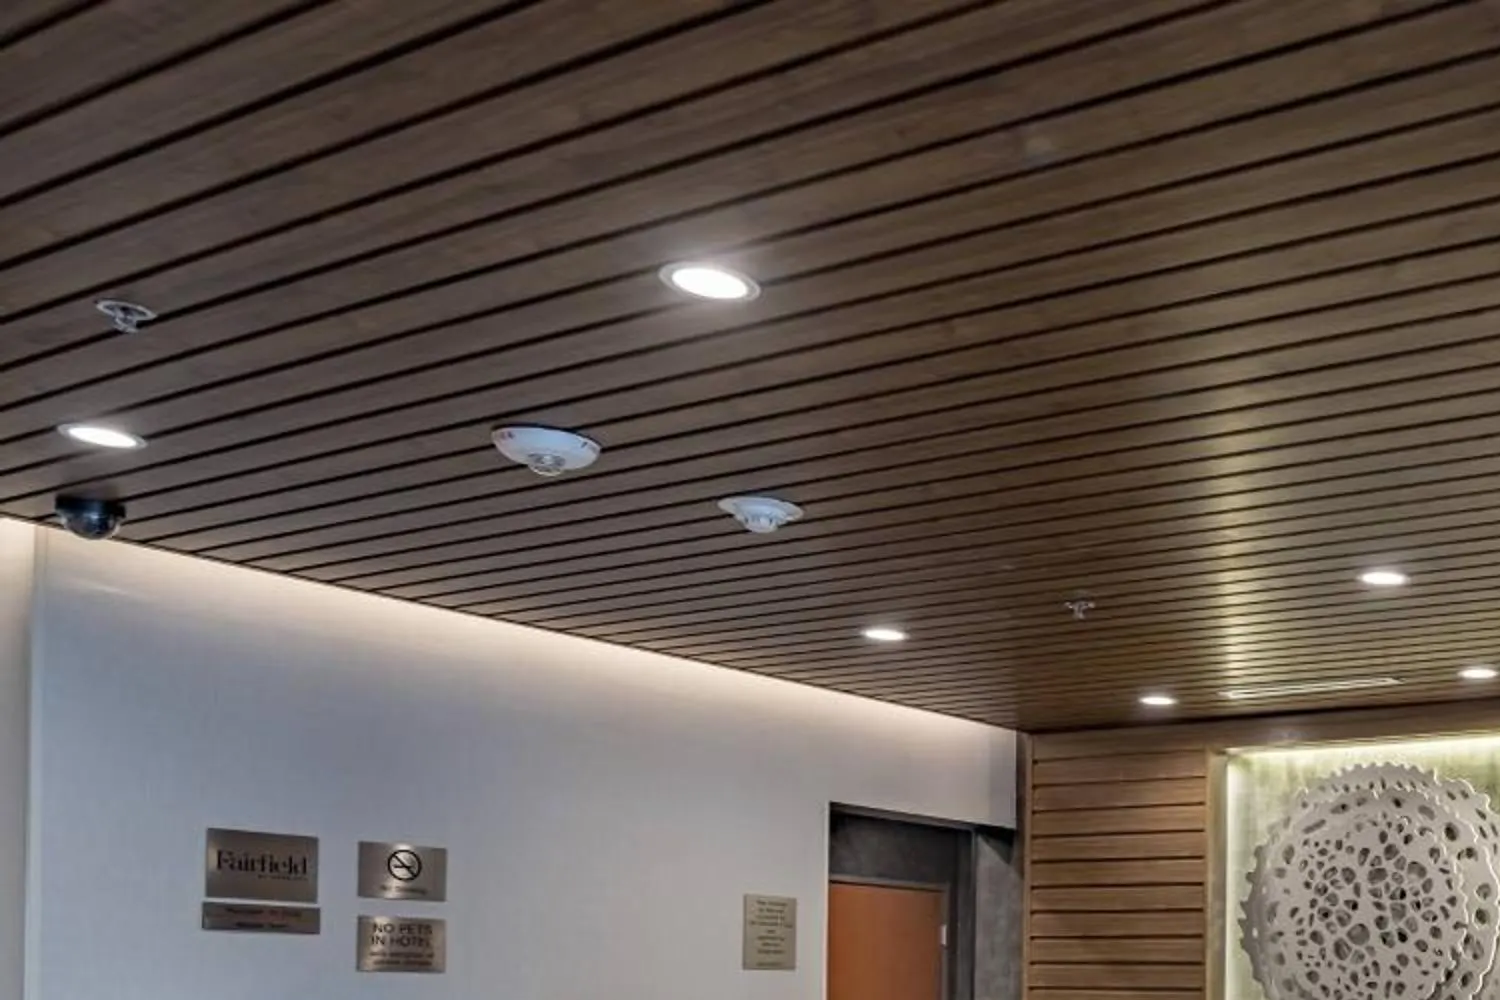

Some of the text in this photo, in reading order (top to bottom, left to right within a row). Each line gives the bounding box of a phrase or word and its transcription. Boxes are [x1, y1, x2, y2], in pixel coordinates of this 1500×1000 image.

[216, 849, 308, 875] Fairfield
[372, 922, 433, 935] NO PETS
[371, 935, 433, 948] IN HOTEL
